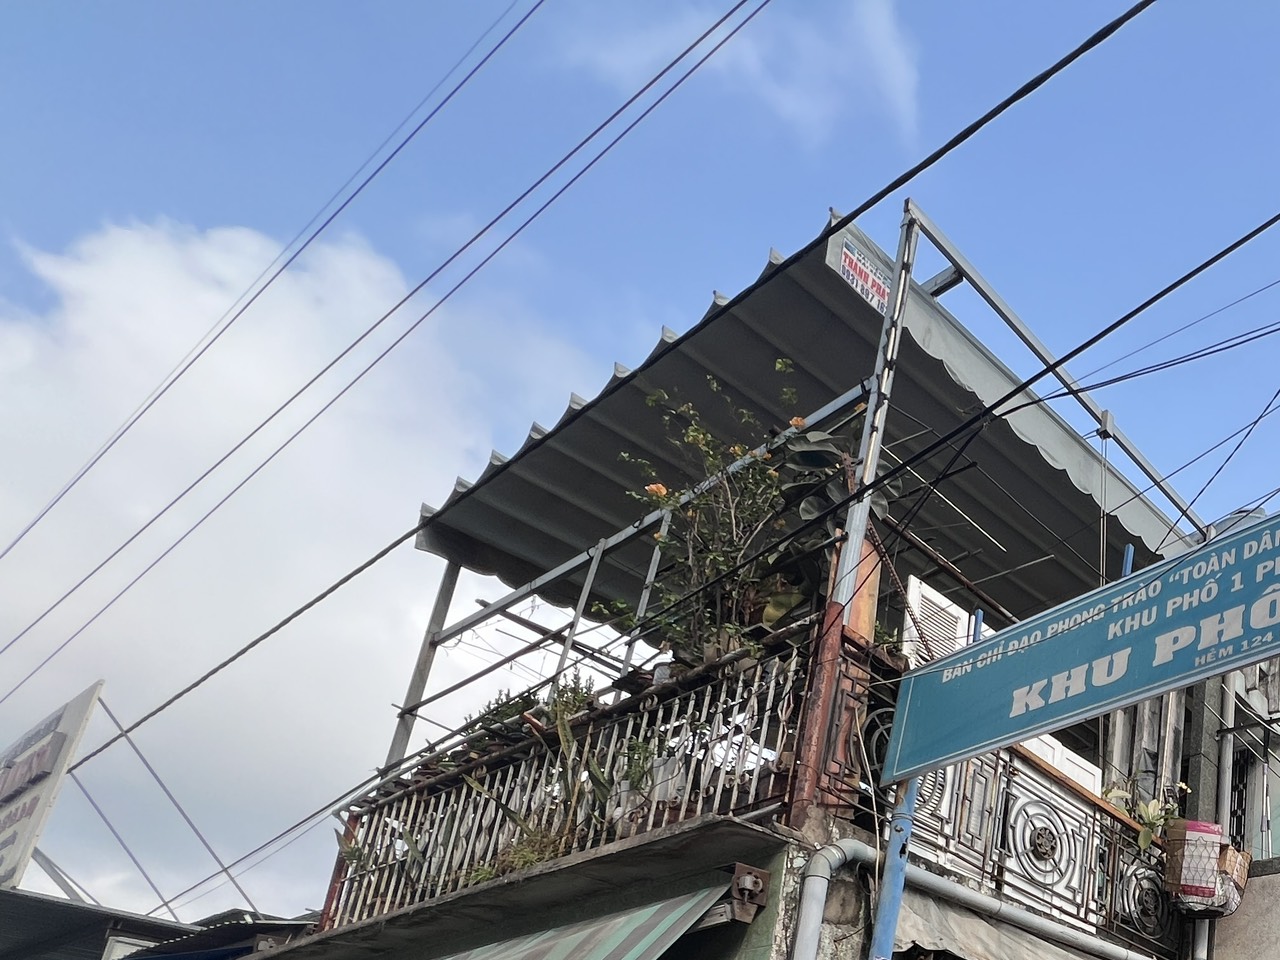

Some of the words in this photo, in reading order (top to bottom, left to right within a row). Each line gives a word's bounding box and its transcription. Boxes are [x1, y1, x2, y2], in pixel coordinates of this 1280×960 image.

[942, 658, 973, 683] BAN
[1008, 630, 1042, 656] ĐẠO
[1046, 605, 1106, 639] PHONG
[1111, 579, 1162, 613] TRÀO
[1107, 606, 1158, 641] KHU
[1166, 575, 1222, 618] PHỐ
[1231, 571, 1244, 593] 1
[1241, 631, 1274, 651] 124
[1009, 647, 1132, 718] KHU
